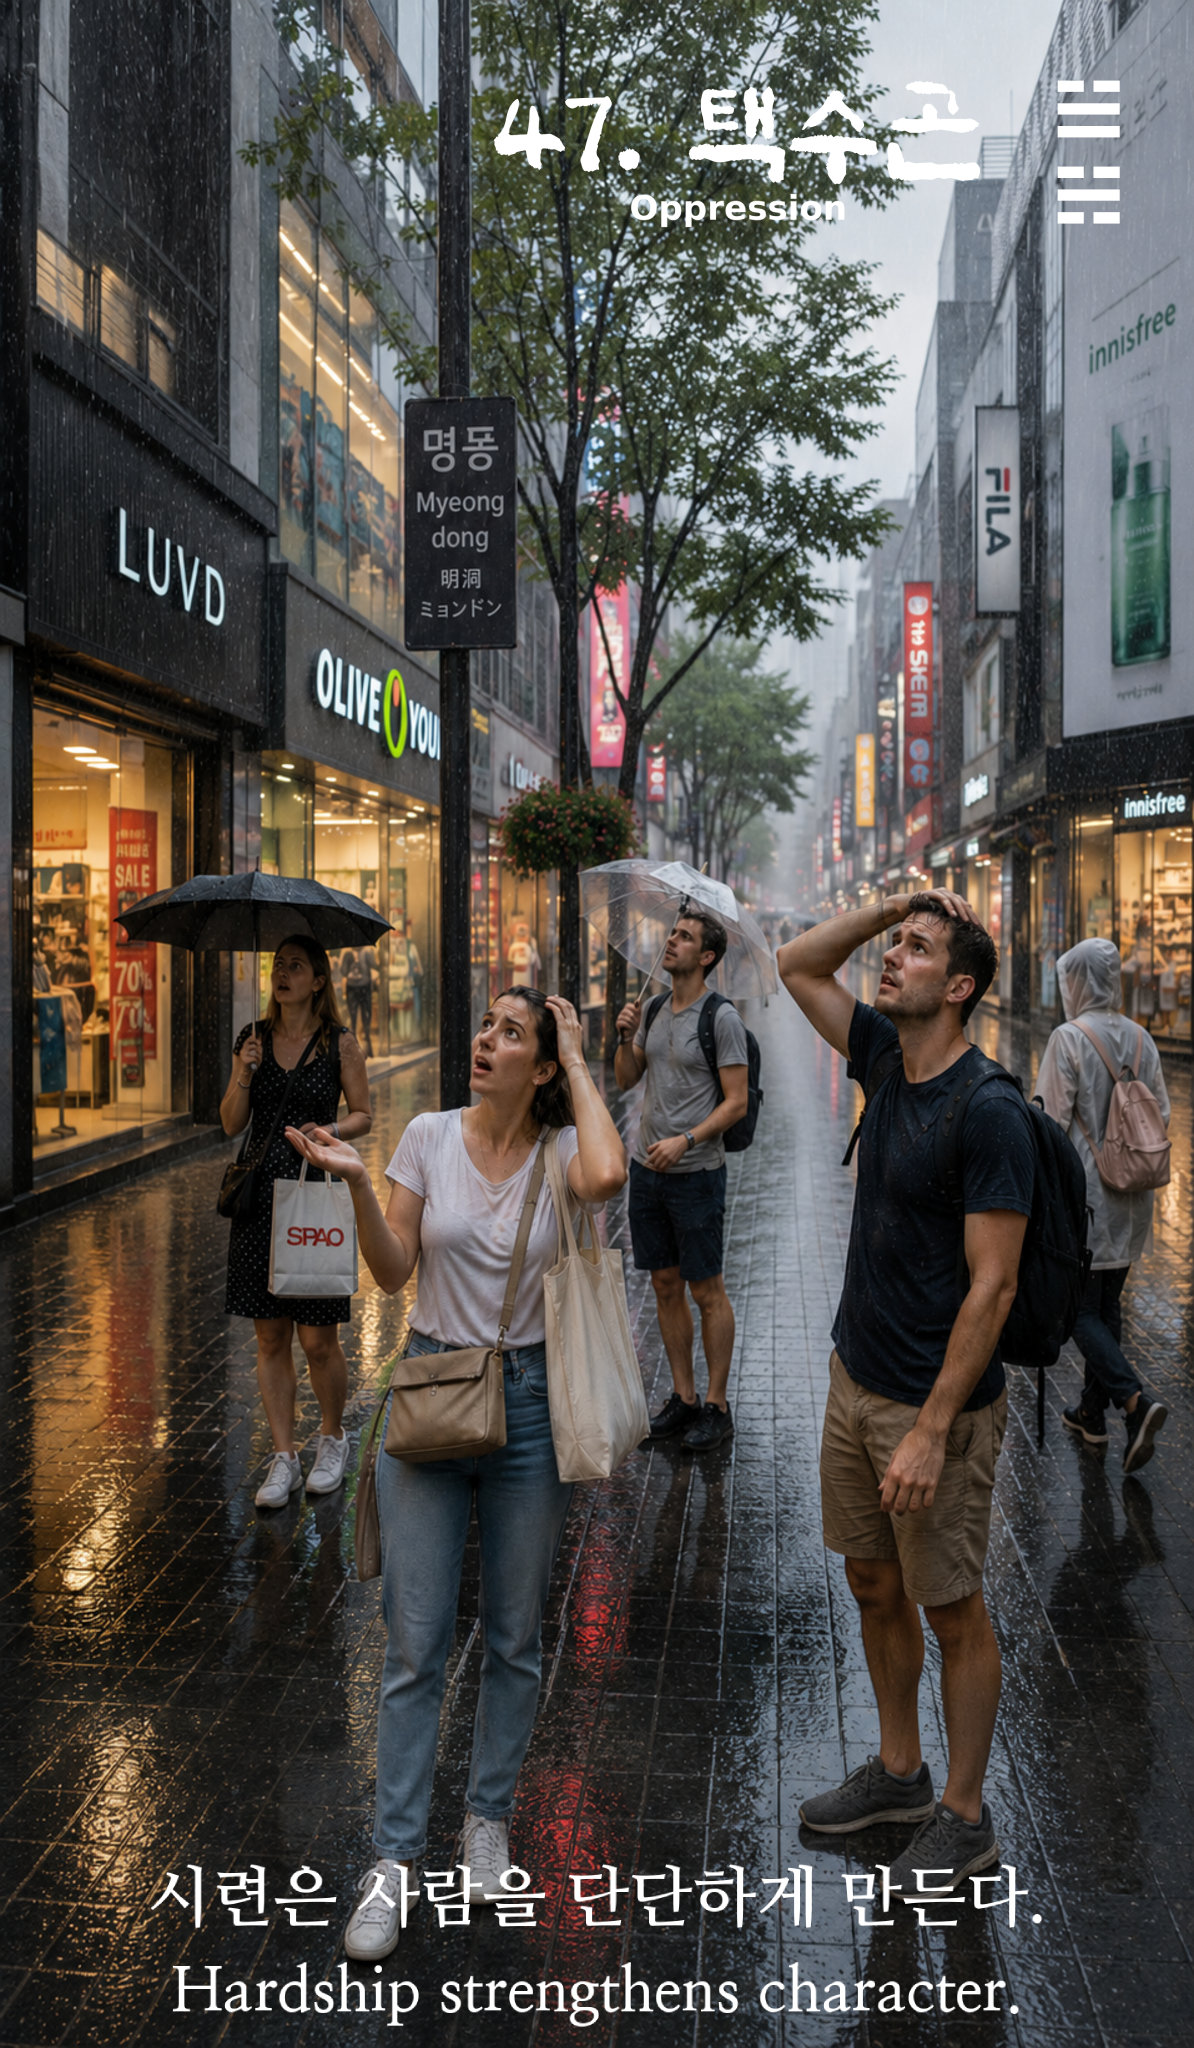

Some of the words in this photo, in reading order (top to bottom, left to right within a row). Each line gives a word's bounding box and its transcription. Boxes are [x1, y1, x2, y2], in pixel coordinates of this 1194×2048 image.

[1088, 302, 1177, 375] innisfree
[423, 426, 499, 473] 명동
[416, 491, 505, 519] Myeong
[985, 467, 1011, 556] FILA
[431, 525, 489, 552] dong
[119, 506, 226, 627] LUVD
[441, 568, 482, 590] 明洞
[420, 598, 502, 619] ミョンドン
[316, 648, 382, 734] OLIVE
[408, 699, 441, 760] YOU
[1123, 792, 1187, 819] innisfree
[114, 863, 151, 888] SALE
[286, 1226, 345, 1247] SPAO
